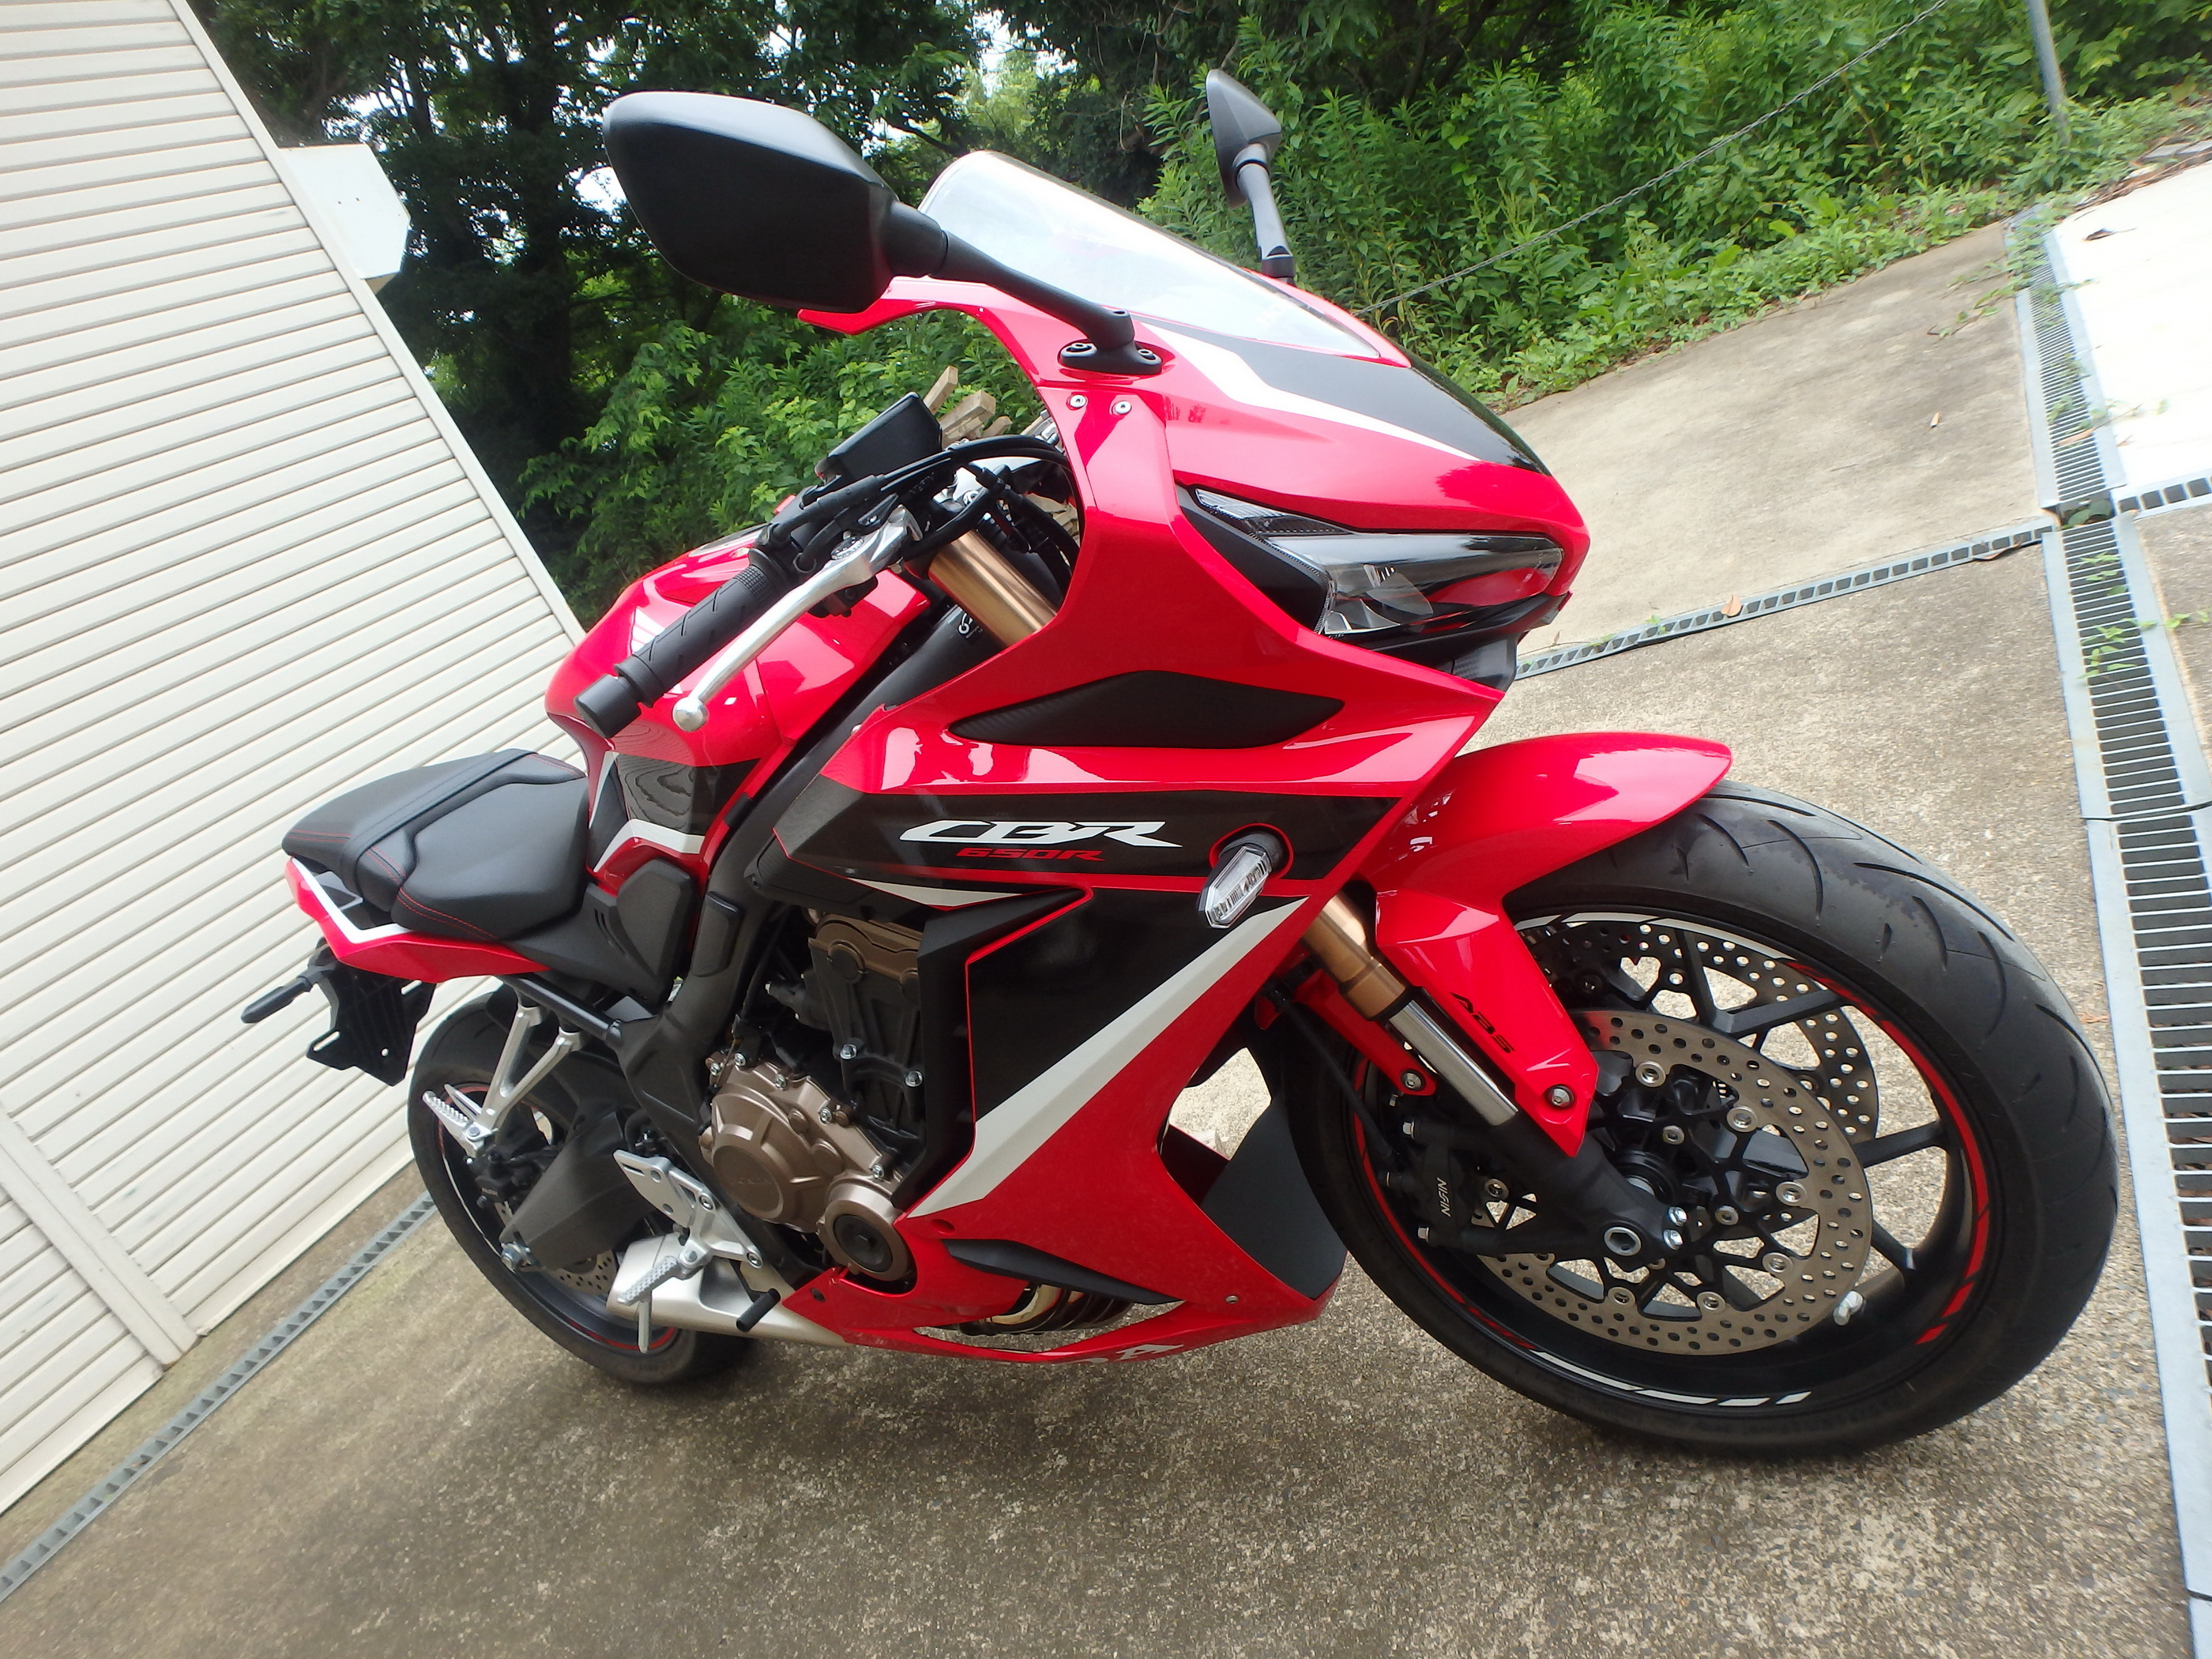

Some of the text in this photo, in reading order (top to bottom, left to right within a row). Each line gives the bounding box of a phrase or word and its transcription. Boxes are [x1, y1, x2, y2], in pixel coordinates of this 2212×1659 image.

[899, 819, 1183, 848] CBR
[956, 847, 1106, 861] 650R
[1450, 991, 1516, 1054] ABS
[1435, 1176, 1452, 1218] NISSIN
